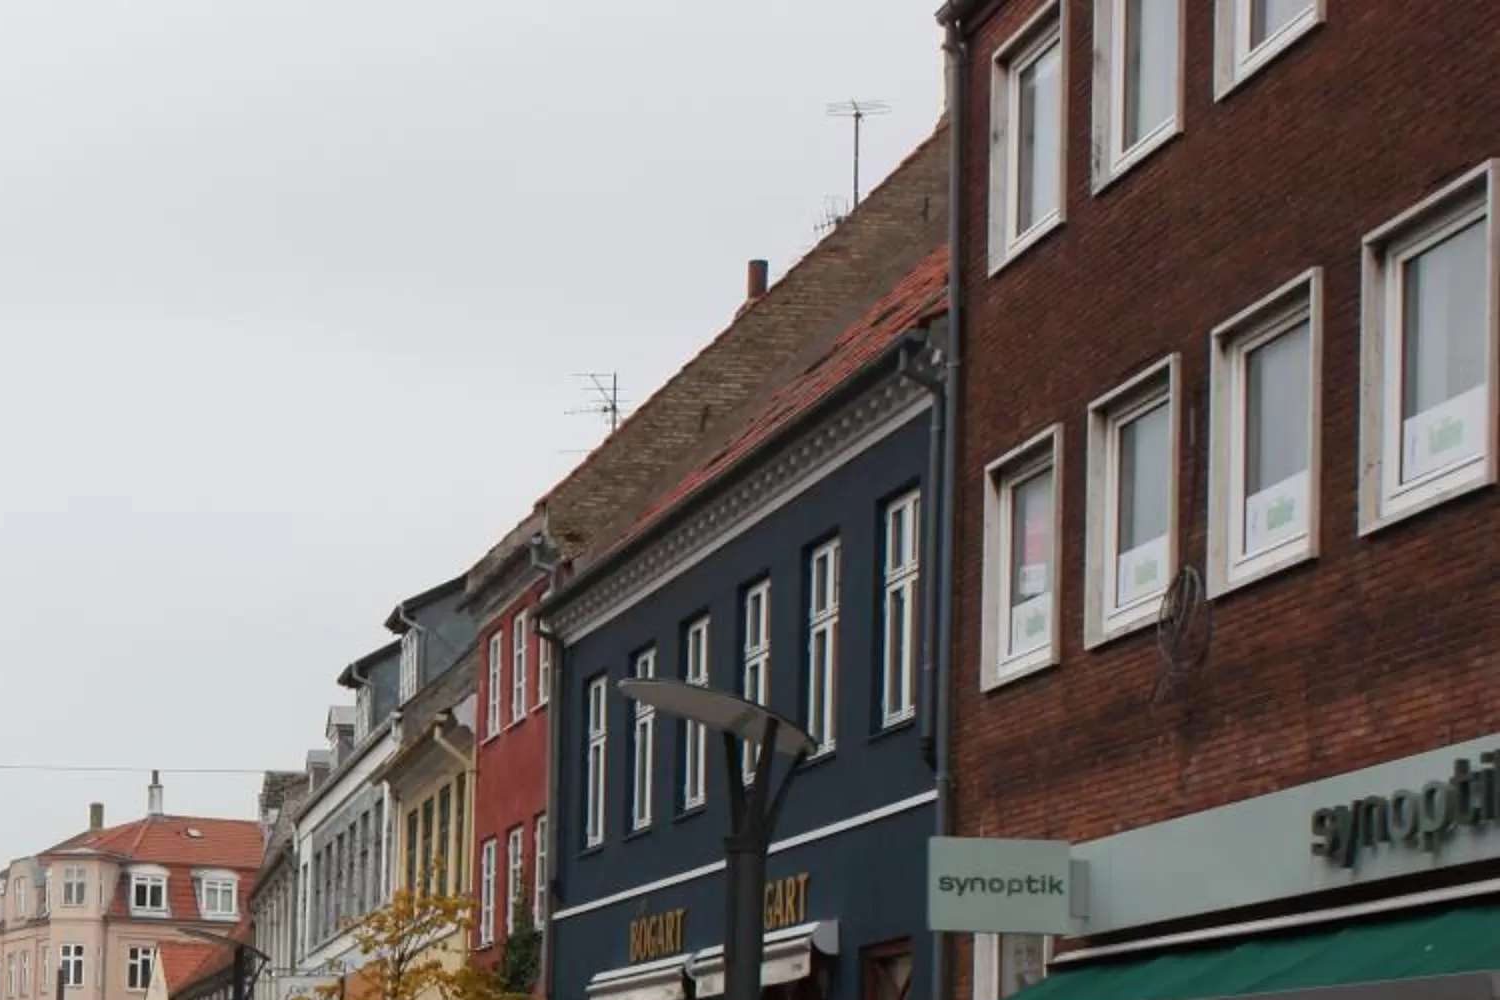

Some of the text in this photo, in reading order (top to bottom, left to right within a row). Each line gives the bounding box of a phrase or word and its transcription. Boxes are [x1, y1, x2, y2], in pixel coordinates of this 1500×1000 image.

[1311, 749, 1500, 868] synopti
[763, 872, 809, 931] GART
[938, 874, 1065, 897] synoptik
[629, 908, 687, 962] BOGART
